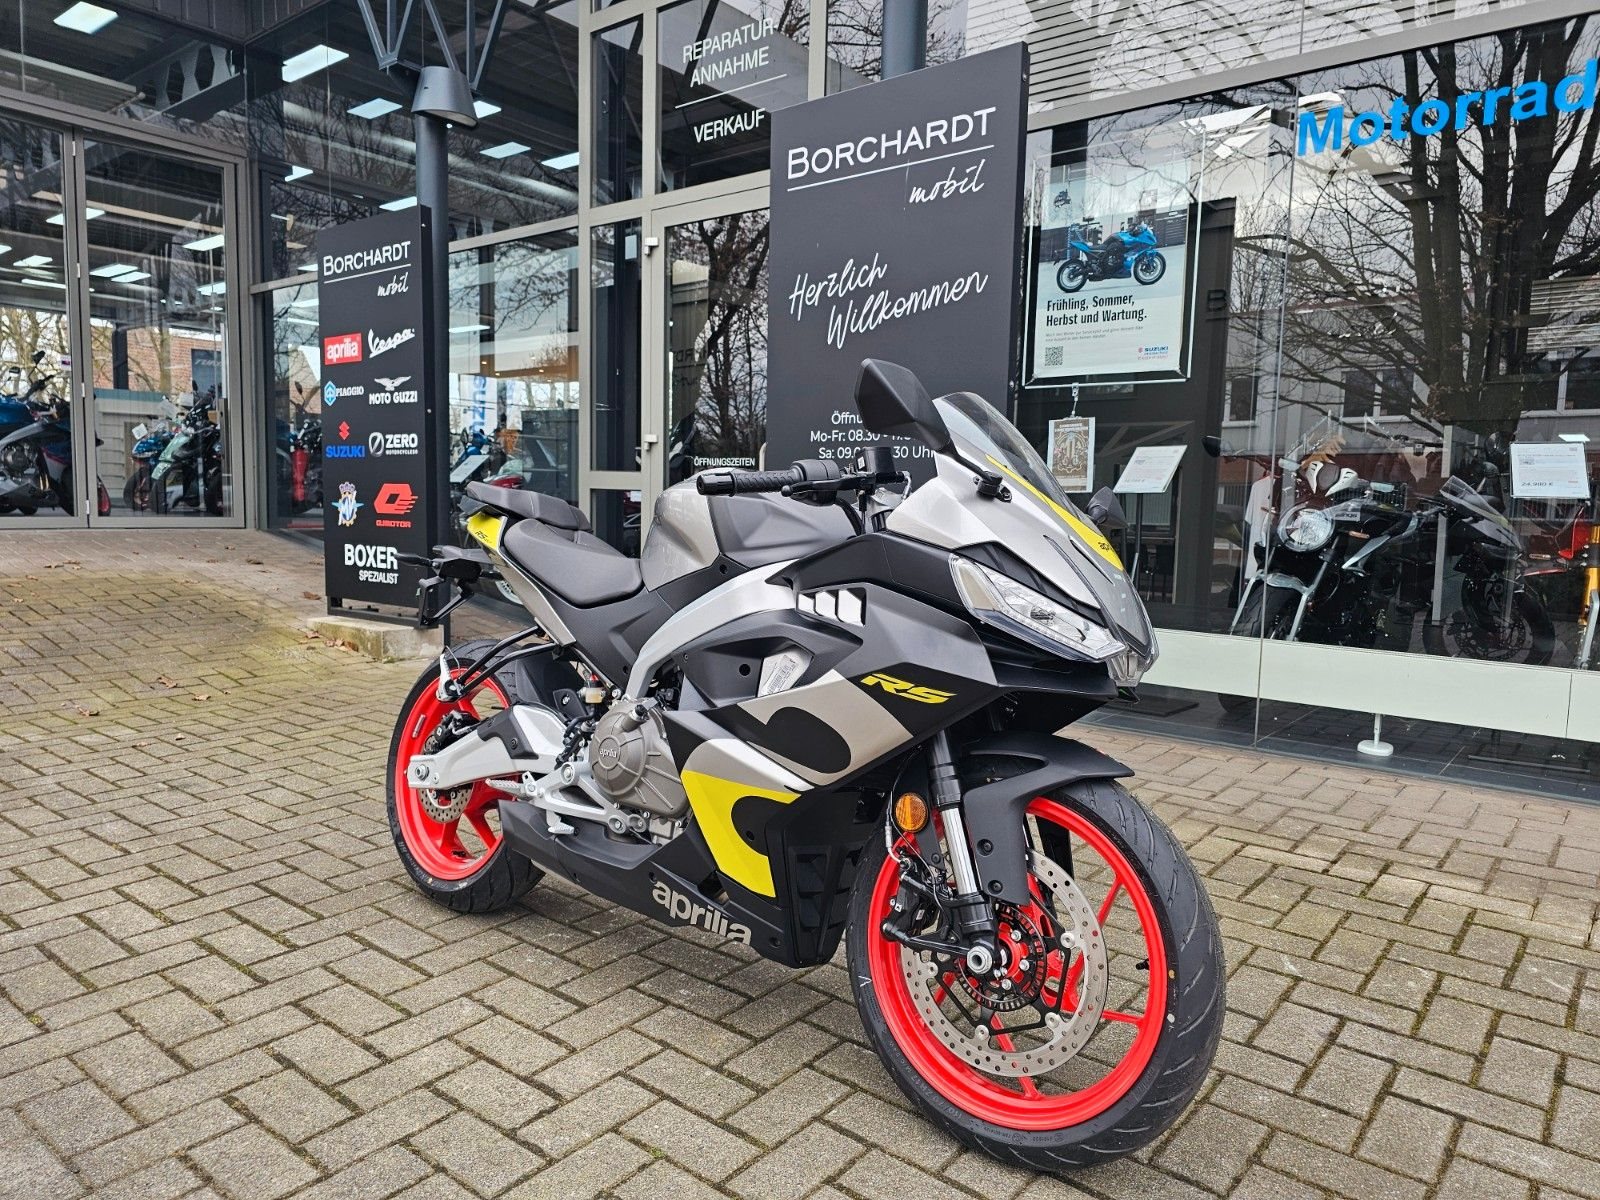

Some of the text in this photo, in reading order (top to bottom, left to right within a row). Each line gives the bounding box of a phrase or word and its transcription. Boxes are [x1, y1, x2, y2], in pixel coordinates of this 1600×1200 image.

[690, 46, 770, 88] ANNAHME
[1297, 57, 1599, 157] Motorrad
[694, 107, 766, 144] VERKAUF
[787, 106, 997, 180] BORCHARDT
[908, 158, 986, 204] mobil
[323, 240, 411, 277] BORCHARDT
[377, 271, 409, 297] mobil
[788, 252, 888, 322] Herzlich
[826, 271, 989, 350] Willkommen
[1046, 293, 1136, 312] Frühling, Sommer,
[1046, 308, 1148, 327] Herbst und Wartung.
[326, 337, 359, 363] aprilia
[367, 328, 416, 359] Vespa
[335, 385, 365, 397] PIAGGIO
[368, 390, 419, 406] MOTO GUZZI
[831, 411, 863, 425] Öffnu
[385, 433, 419, 449] ZERO
[810, 430, 846, 443] Mo-Fr:
[325, 445, 366, 458] SUZUKI
[693, 456, 756, 467] ÖFFNUNGSZEITEN
[818, 447, 835, 459] Sa:
[837, 446, 861, 459] 09.0
[892, 445, 909, 459] 30
[343, 543, 399, 570] BOXER
[358, 569, 399, 585] SPEZIALIST
[860, 672, 958, 705] RS
[652, 880, 752, 946] aprilia
